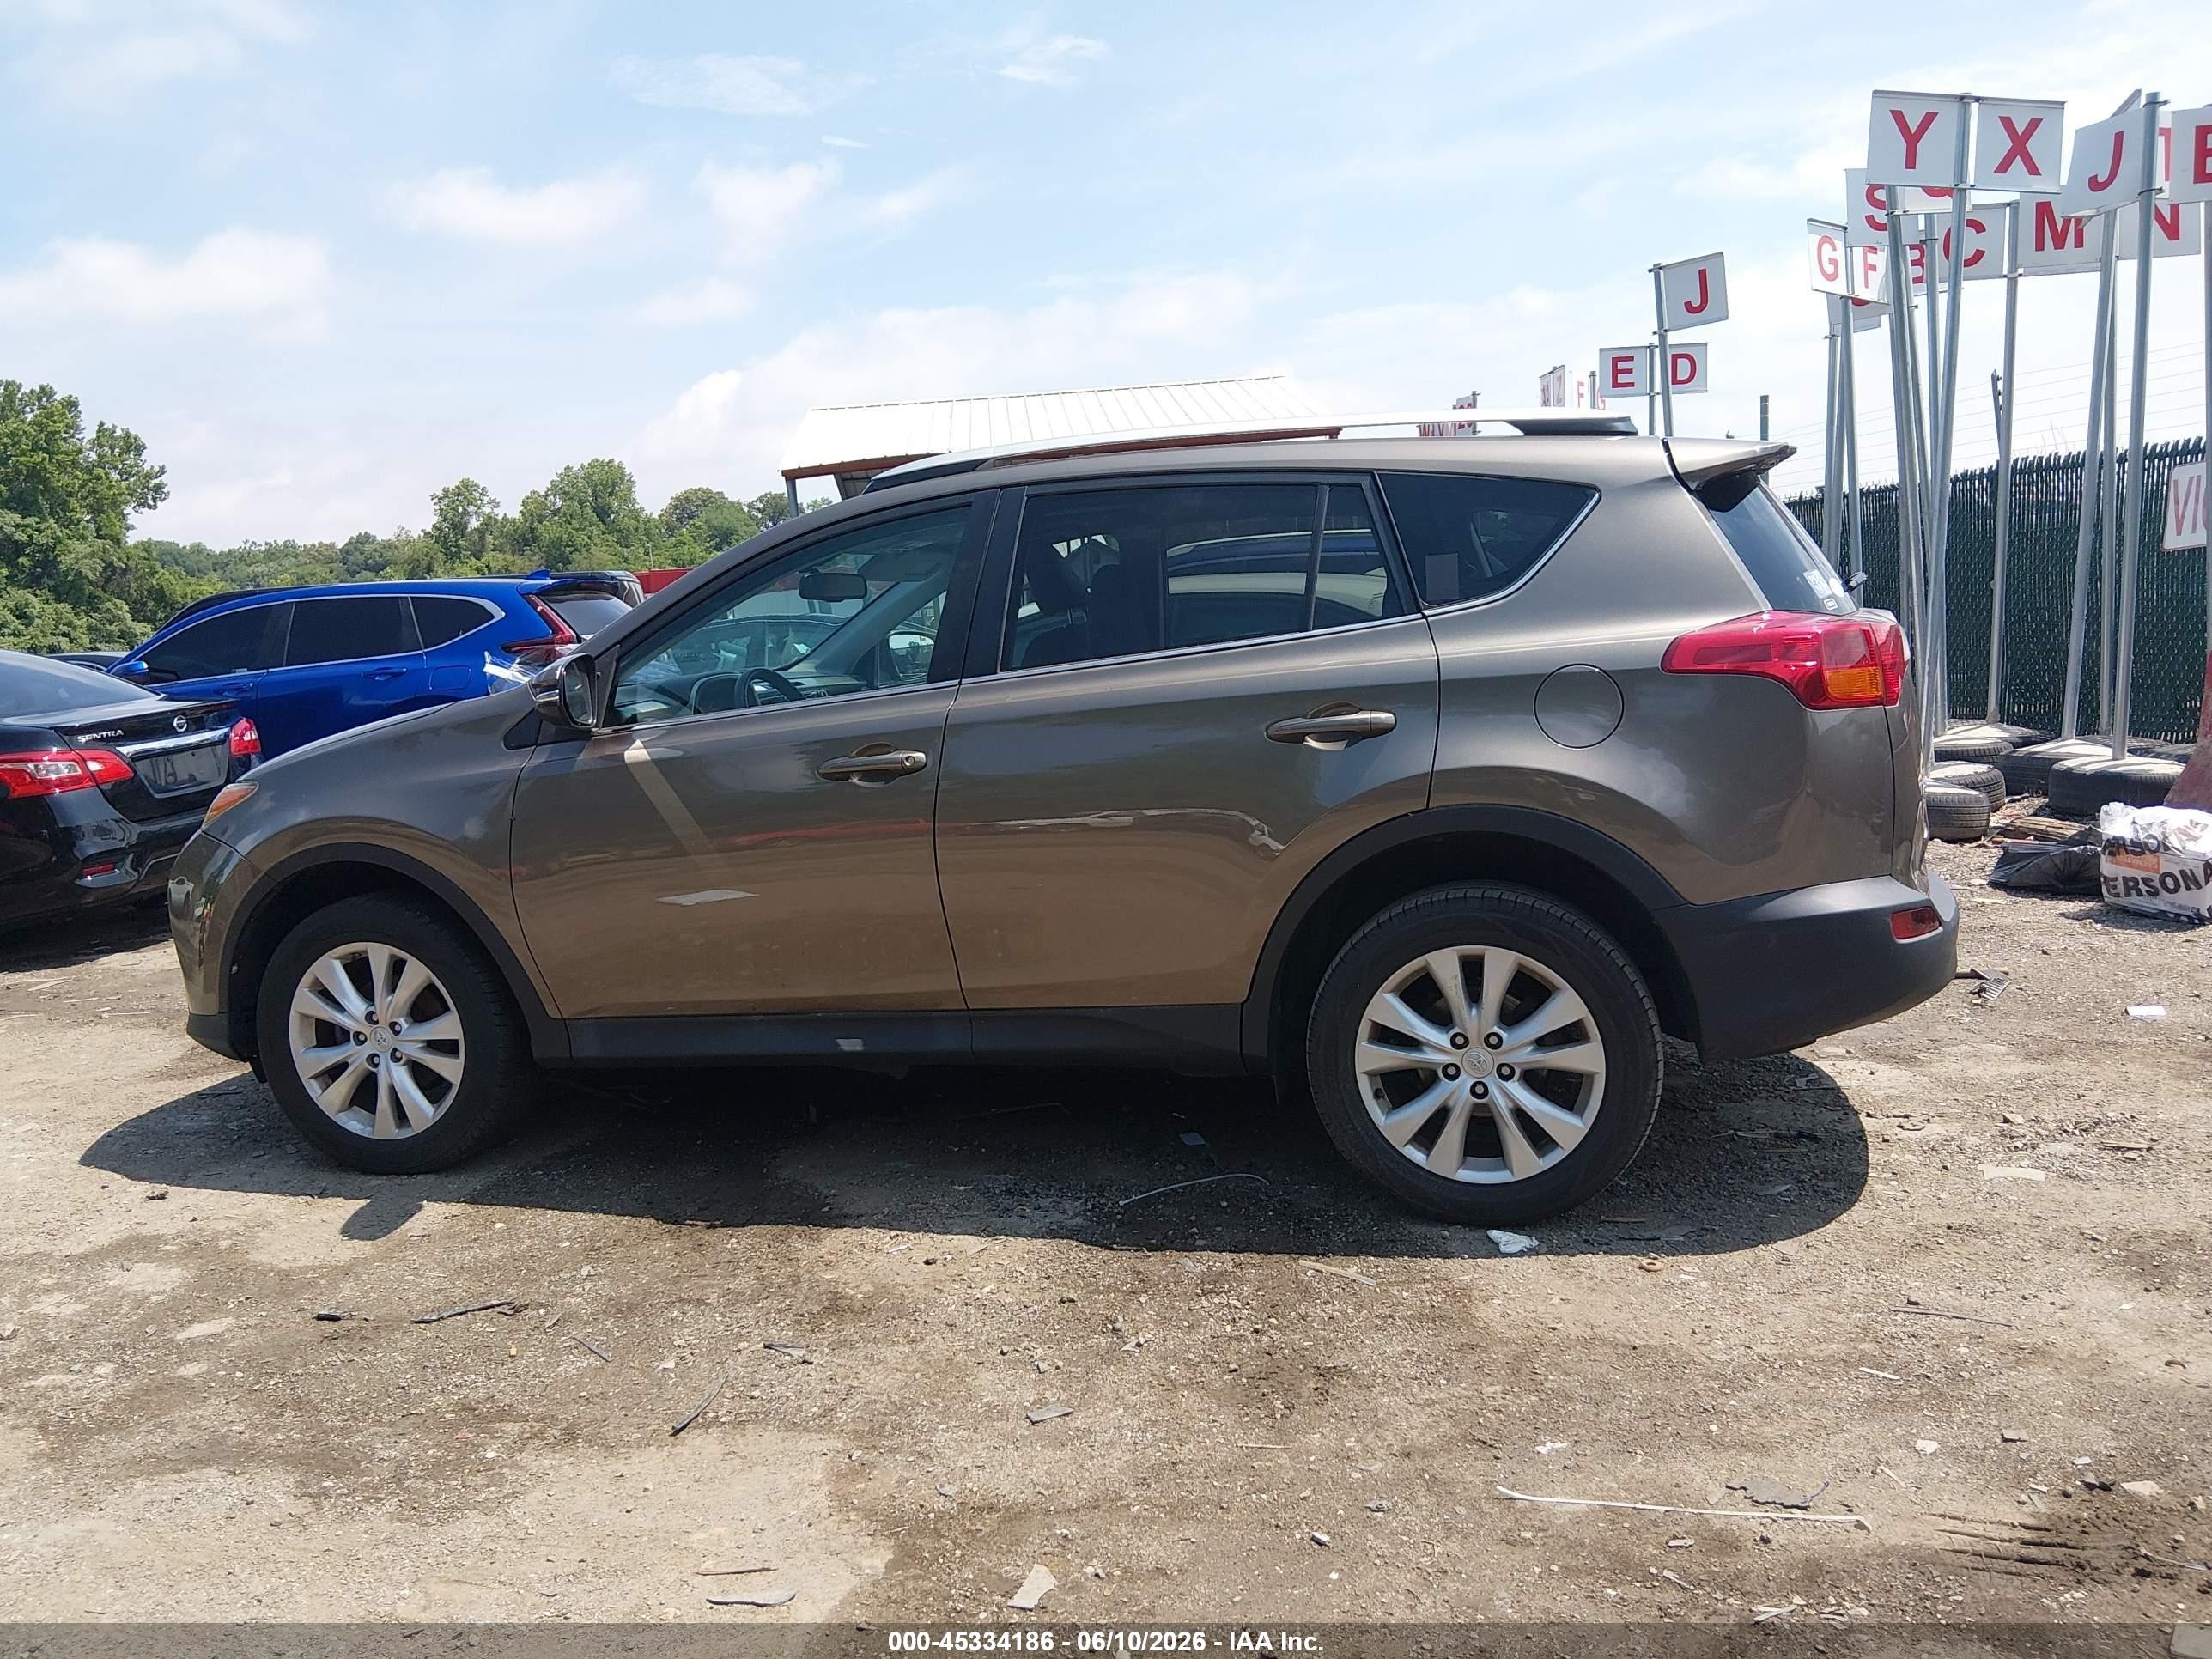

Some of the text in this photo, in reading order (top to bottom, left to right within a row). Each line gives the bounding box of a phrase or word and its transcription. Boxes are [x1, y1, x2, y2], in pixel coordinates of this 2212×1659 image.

[1889, 109, 1939, 169] Y
[1993, 116, 2044, 176] X
[2087, 131, 2124, 192] J
[1943, 219, 1986, 268] C
[2035, 201, 2084, 252] M
[1816, 235, 1839, 282] G
[1863, 246, 1878, 289] F
[1684, 268, 1709, 314] J
[1577, 380, 1585, 409] F
[1611, 353, 1698, 389] E D
[77, 729, 125, 743] SENTRA
